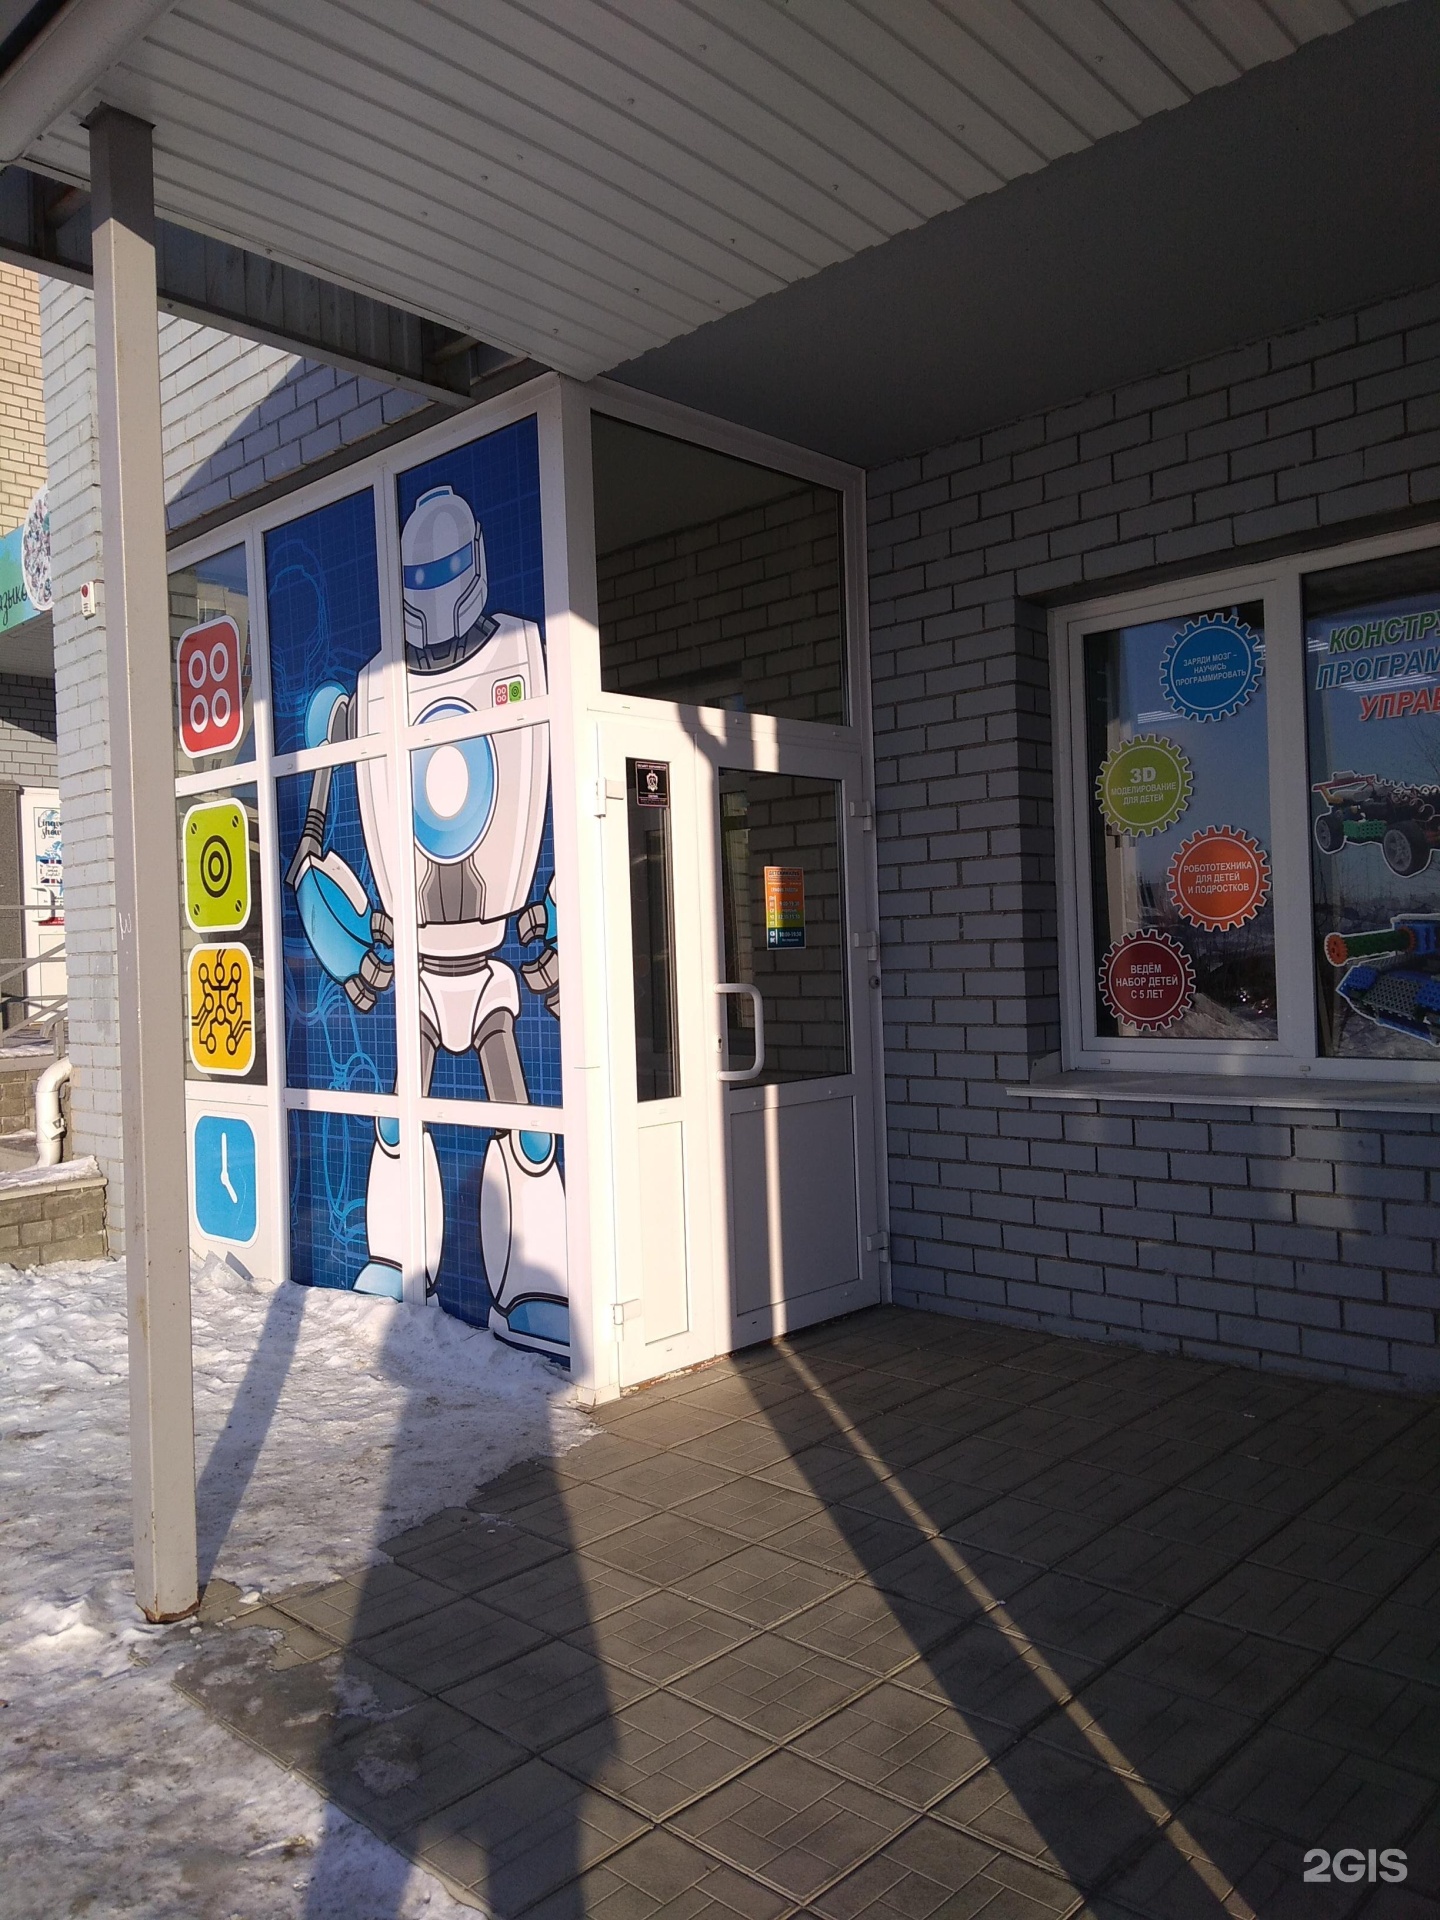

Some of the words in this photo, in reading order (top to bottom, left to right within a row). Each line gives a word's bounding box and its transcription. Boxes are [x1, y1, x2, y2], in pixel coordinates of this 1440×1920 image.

[1183, 655, 1211, 667] ЗАРЯДИ
[1212, 652, 1231, 662] МОЗГ
[1193, 662, 1227, 674] НАУЧИСЬ
[1175, 669, 1247, 686] ПРОГРАММИРОВАТЬ
[1130, 766, 1156, 784] 3D
[1111, 781, 1177, 796] МОДЕЛИРОВАНИЕ
[1123, 796, 1139, 806] ДЛЯ
[1140, 793, 1164, 805] ДЕТЕЙ
[1183, 861, 1252, 873] РОБОТОТЕХНИКА
[1196, 874, 1212, 884] ДЛЯ
[1214, 871, 1240, 883] ДЕТЕЙ
[1187, 886, 1194, 894] И
[1195, 883, 1250, 894] ПОДРОСТКОВ
[1130, 962, 1162, 975] ВЕДЁМ
[1115, 977, 1147, 987] НАБОР
[1148, 974, 1179, 988] ДЕТЕЙ
[1130, 990, 1138, 999] С
[1139, 990, 1145, 999] 5
[1146, 989, 1164, 999] ЛЕТ
